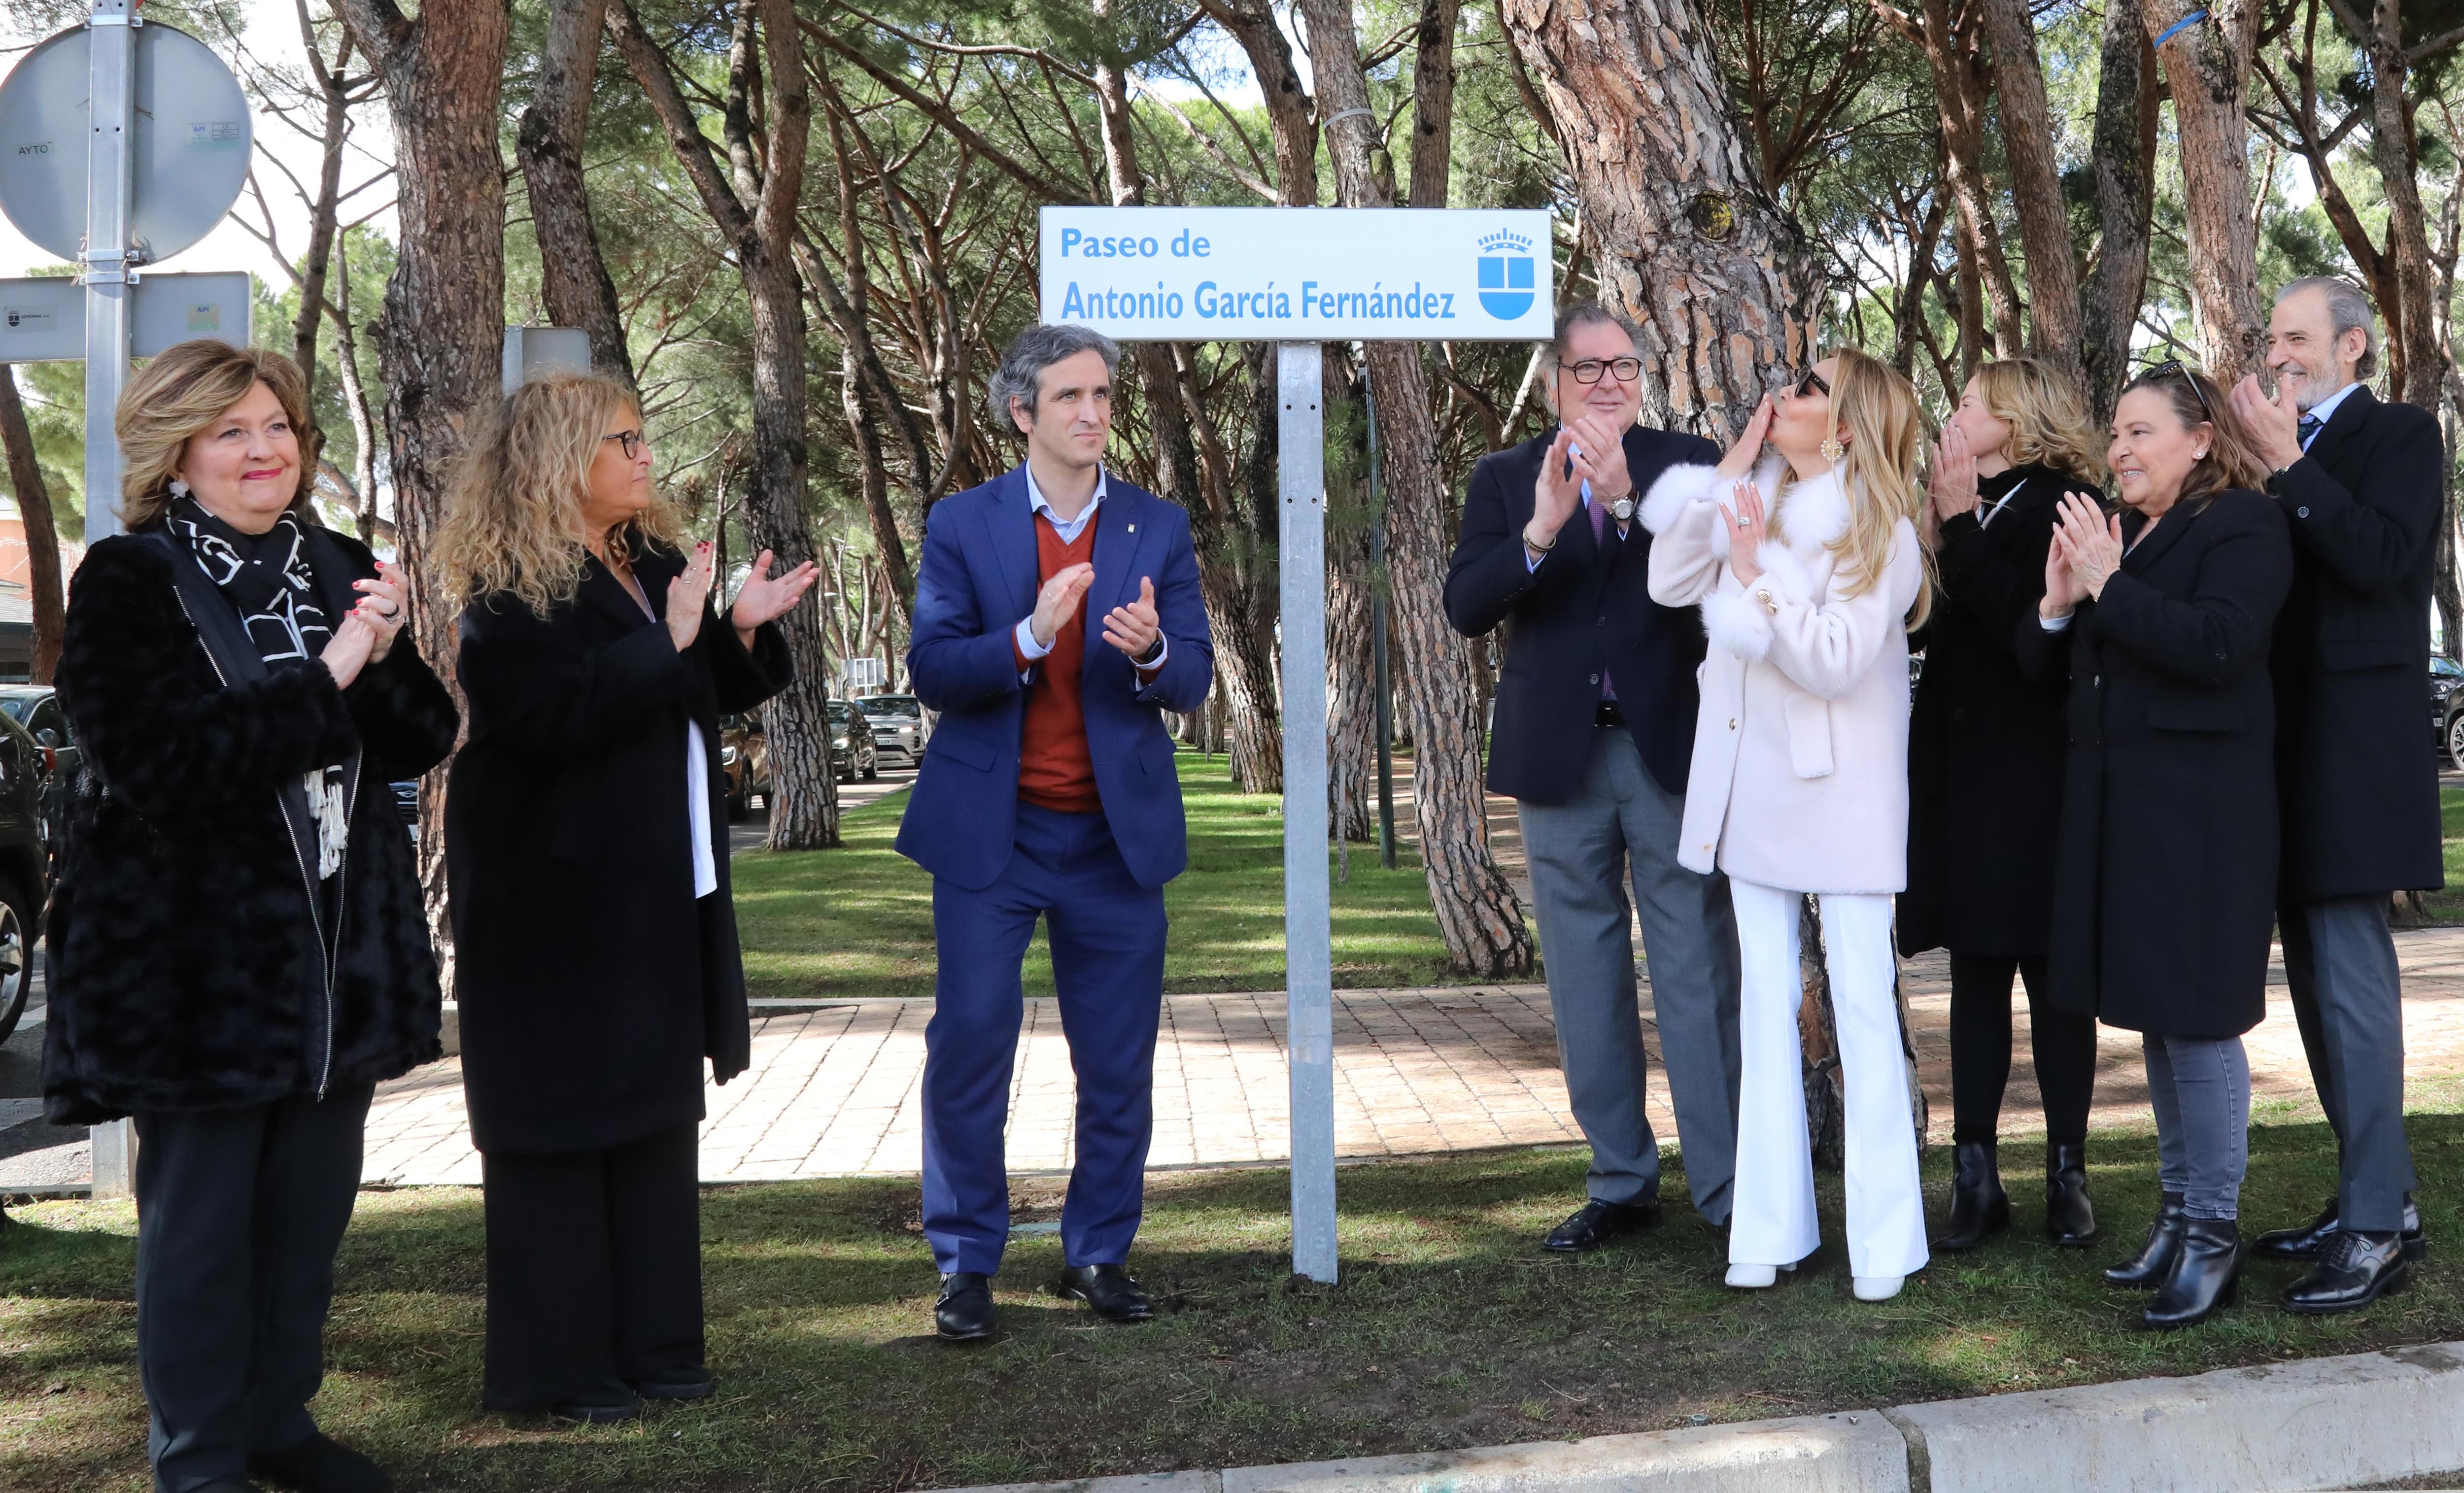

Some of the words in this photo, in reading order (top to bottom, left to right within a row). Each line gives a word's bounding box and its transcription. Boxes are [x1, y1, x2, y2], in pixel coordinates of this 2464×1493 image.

[19, 144, 48, 155] AYTO
[1061, 228, 1159, 258] Paseo
[1170, 228, 1211, 258] de
[1061, 280, 1184, 320] Antonio
[1194, 280, 1293, 320] García
[1302, 280, 1456, 319] Fernández
